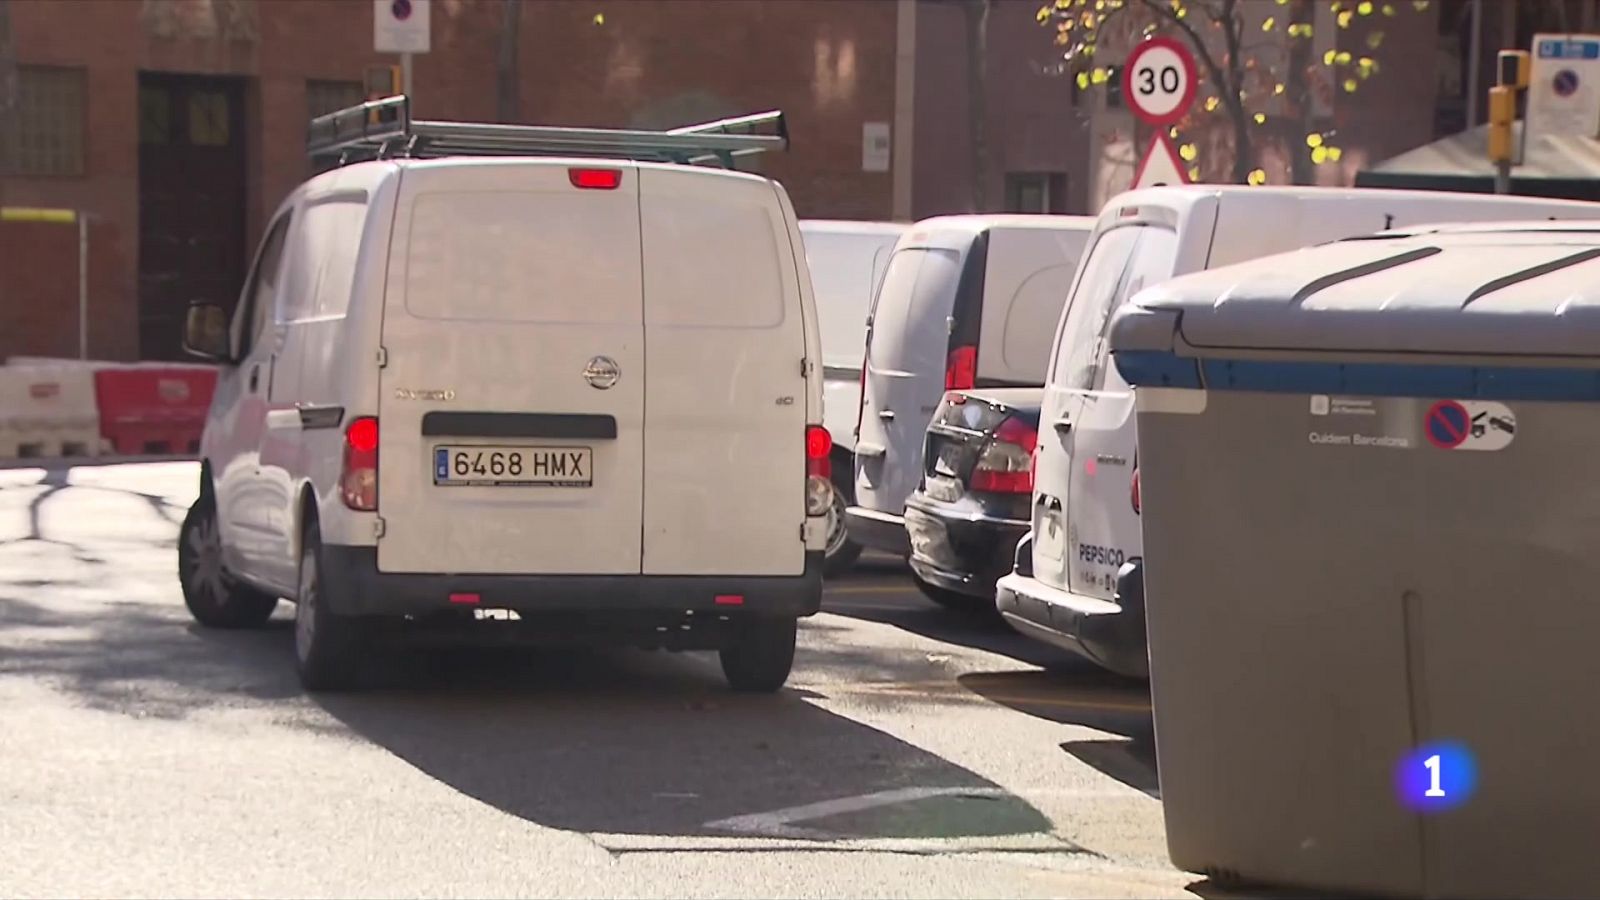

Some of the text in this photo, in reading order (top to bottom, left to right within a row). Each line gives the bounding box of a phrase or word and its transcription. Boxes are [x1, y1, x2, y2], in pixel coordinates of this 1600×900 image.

[1138, 66, 1179, 95] 30
[1308, 432, 1408, 447] Cuidem Barcelona
[454, 452, 583, 477] 6468 HMX
[1079, 543, 1124, 568] PEPSICO
